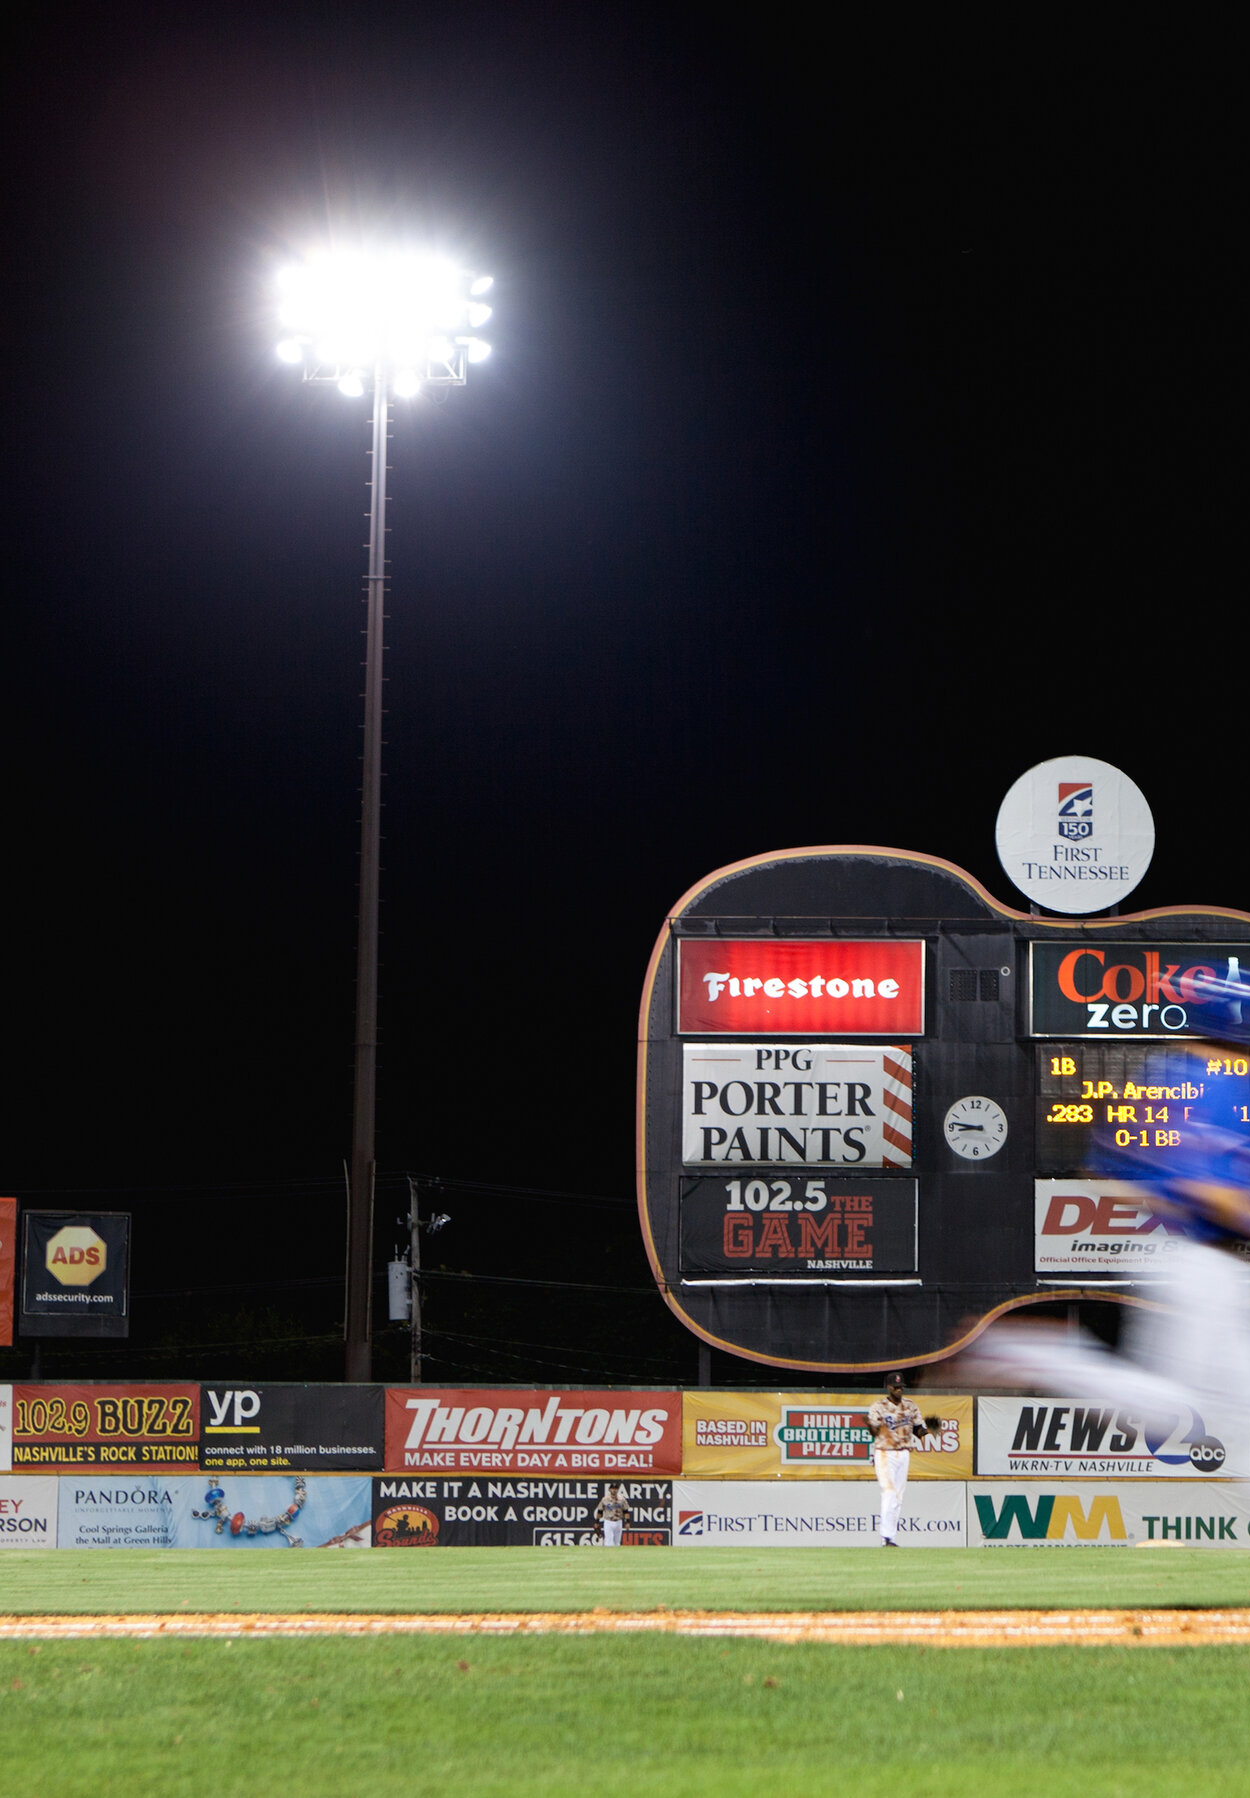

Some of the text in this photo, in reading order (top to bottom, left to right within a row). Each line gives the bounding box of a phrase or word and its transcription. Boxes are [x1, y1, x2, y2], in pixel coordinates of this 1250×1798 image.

[1062, 823, 1090, 836] 150
[1053, 845, 1102, 861] FIRST
[1022, 863, 1129, 880] TENNESSEE
[1057, 948, 1217, 1004] Coke
[703, 972, 900, 1002] Firestone
[1087, 1003, 1187, 1030] zero
[755, 1048, 813, 1071] PPG
[1050, 1057, 1248, 1076] 1B #10
[690, 1080, 876, 1116] PORTER
[1081, 1081, 1206, 1099] J.P. Arencibi
[970, 1100, 982, 1109] 12
[1047, 1105, 1093, 1122] .283
[1106, 1105, 1138, 1123] HR
[1144, 1106, 1169, 1122] 14
[700, 1126, 867, 1163] PAINTS
[1155, 1130, 1181, 1147] BB
[725, 1180, 873, 1212] 102.5 THE
[723, 1212, 873, 1258] GAME
[52, 1246, 100, 1265] ADS
[1071, 1240, 1157, 1255] imaging
[807, 1260, 873, 1269] NASHVILLE
[36, 1291, 113, 1304] adssecurity.com
[207, 1389, 261, 1426] yp
[14, 1396, 194, 1438] 102.9 BUZZ
[404, 1397, 669, 1450] THORNTONS
[803, 1414, 853, 1428] HUNT
[697, 1420, 767, 1433] BASED IN
[784, 1428, 873, 1442] BROTHERS
[1011, 1406, 1139, 1452] NEWS
[697, 1435, 767, 1446] NASHVILLE
[803, 1442, 854, 1456] PIZZA
[14, 1445, 198, 1462] NASHVILLE'S ROCK STATION!
[205, 1445, 376, 1454] connect with 18 million businesses.
[1190, 1445, 1225, 1461] abc
[205, 1457, 291, 1467] one app, one site.
[404, 1452, 653, 1468] MAKE EVERY DAY A BIG DEAL!
[1008, 1460, 1154, 1472] WKRN-TV NASHVILLE
[75, 1489, 173, 1504] PANDORA
[380, 1481, 437, 1498] MAKE
[443, 1482, 462, 1498] IT
[468, 1482, 483, 1498] A
[488, 1482, 598, 1499] NASHVILLE
[445, 1506, 588, 1522] BOOK A GROUP
[973, 1495, 1128, 1539] WM
[79, 1525, 169, 1535] Cool Springs Galleria
[1142, 1516, 1238, 1540] THINK
[153, 1537, 172, 1545] Hills
